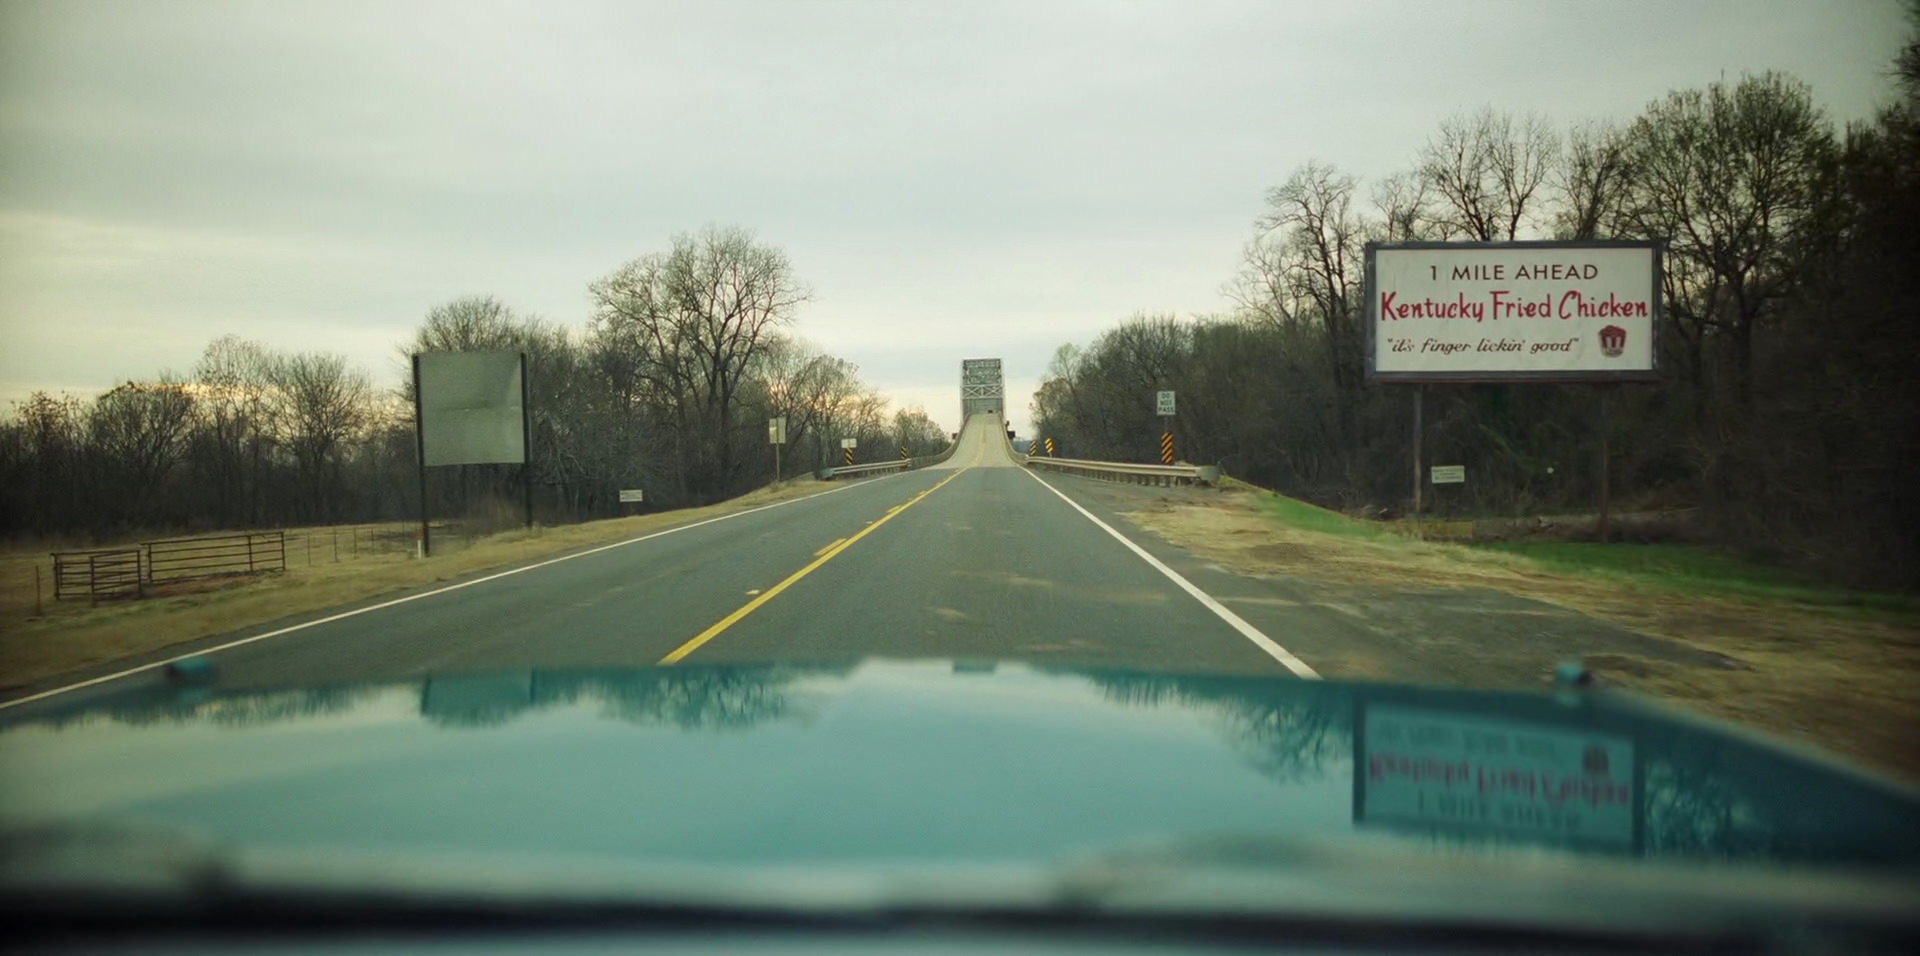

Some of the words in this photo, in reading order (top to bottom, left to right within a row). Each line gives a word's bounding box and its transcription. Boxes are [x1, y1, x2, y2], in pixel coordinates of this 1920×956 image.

[1430, 265, 1437, 280] 1
[1451, 264, 1504, 280] MILE
[1514, 264, 1599, 280] AHEAD
[1381, 291, 1484, 323] Kentucky
[1489, 290, 1552, 320] Fried
[1558, 290, 1648, 320] Chicken
[1420, 338, 1472, 355] finger
